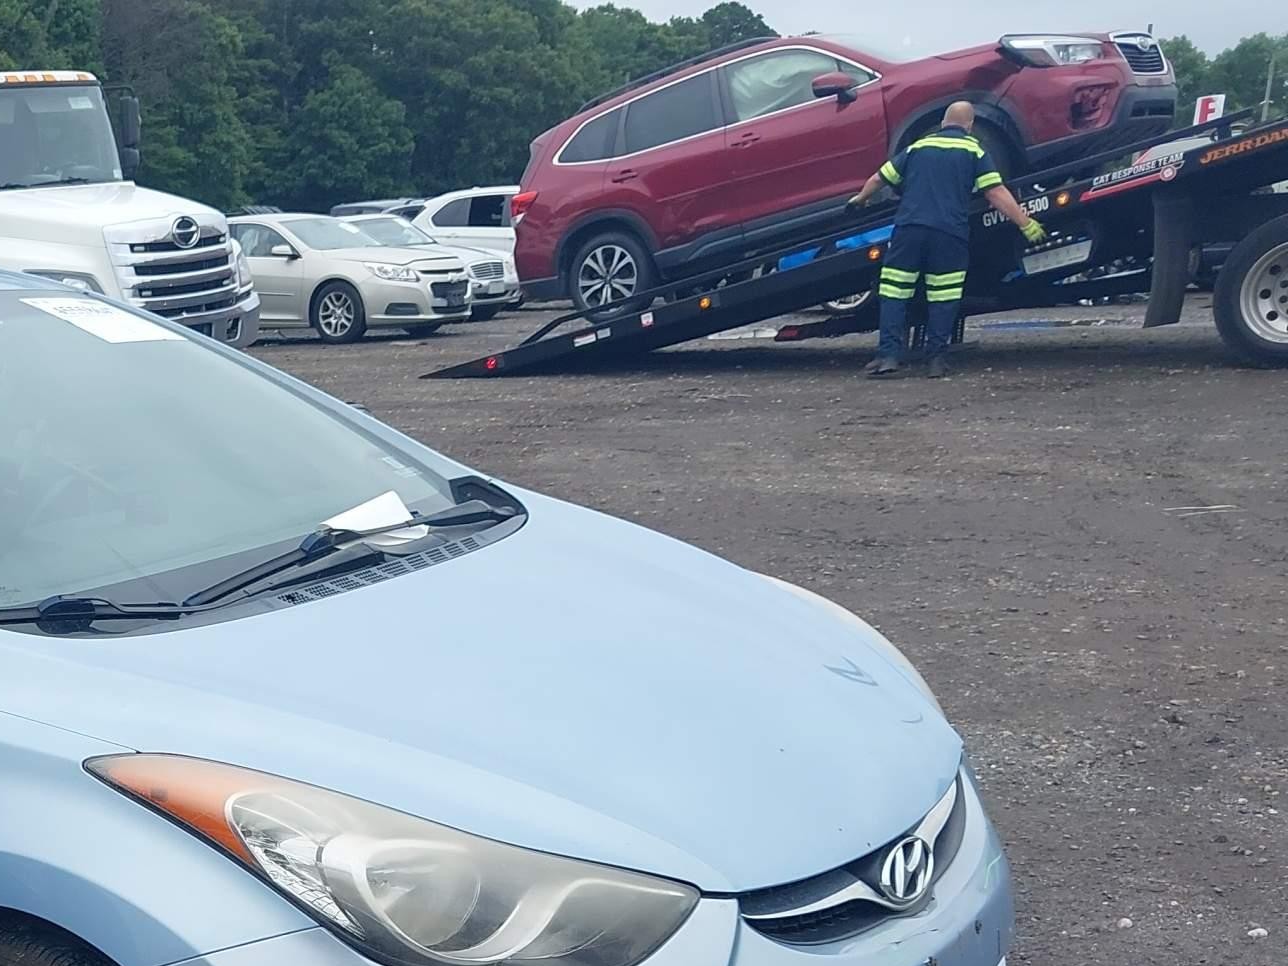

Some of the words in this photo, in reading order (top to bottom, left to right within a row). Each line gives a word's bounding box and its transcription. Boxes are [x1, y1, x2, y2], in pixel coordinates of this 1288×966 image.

[1093, 173, 1111, 186] CAT
[1111, 161, 1157, 180] RESPONSE
[1158, 152, 1184, 167] TEAM
